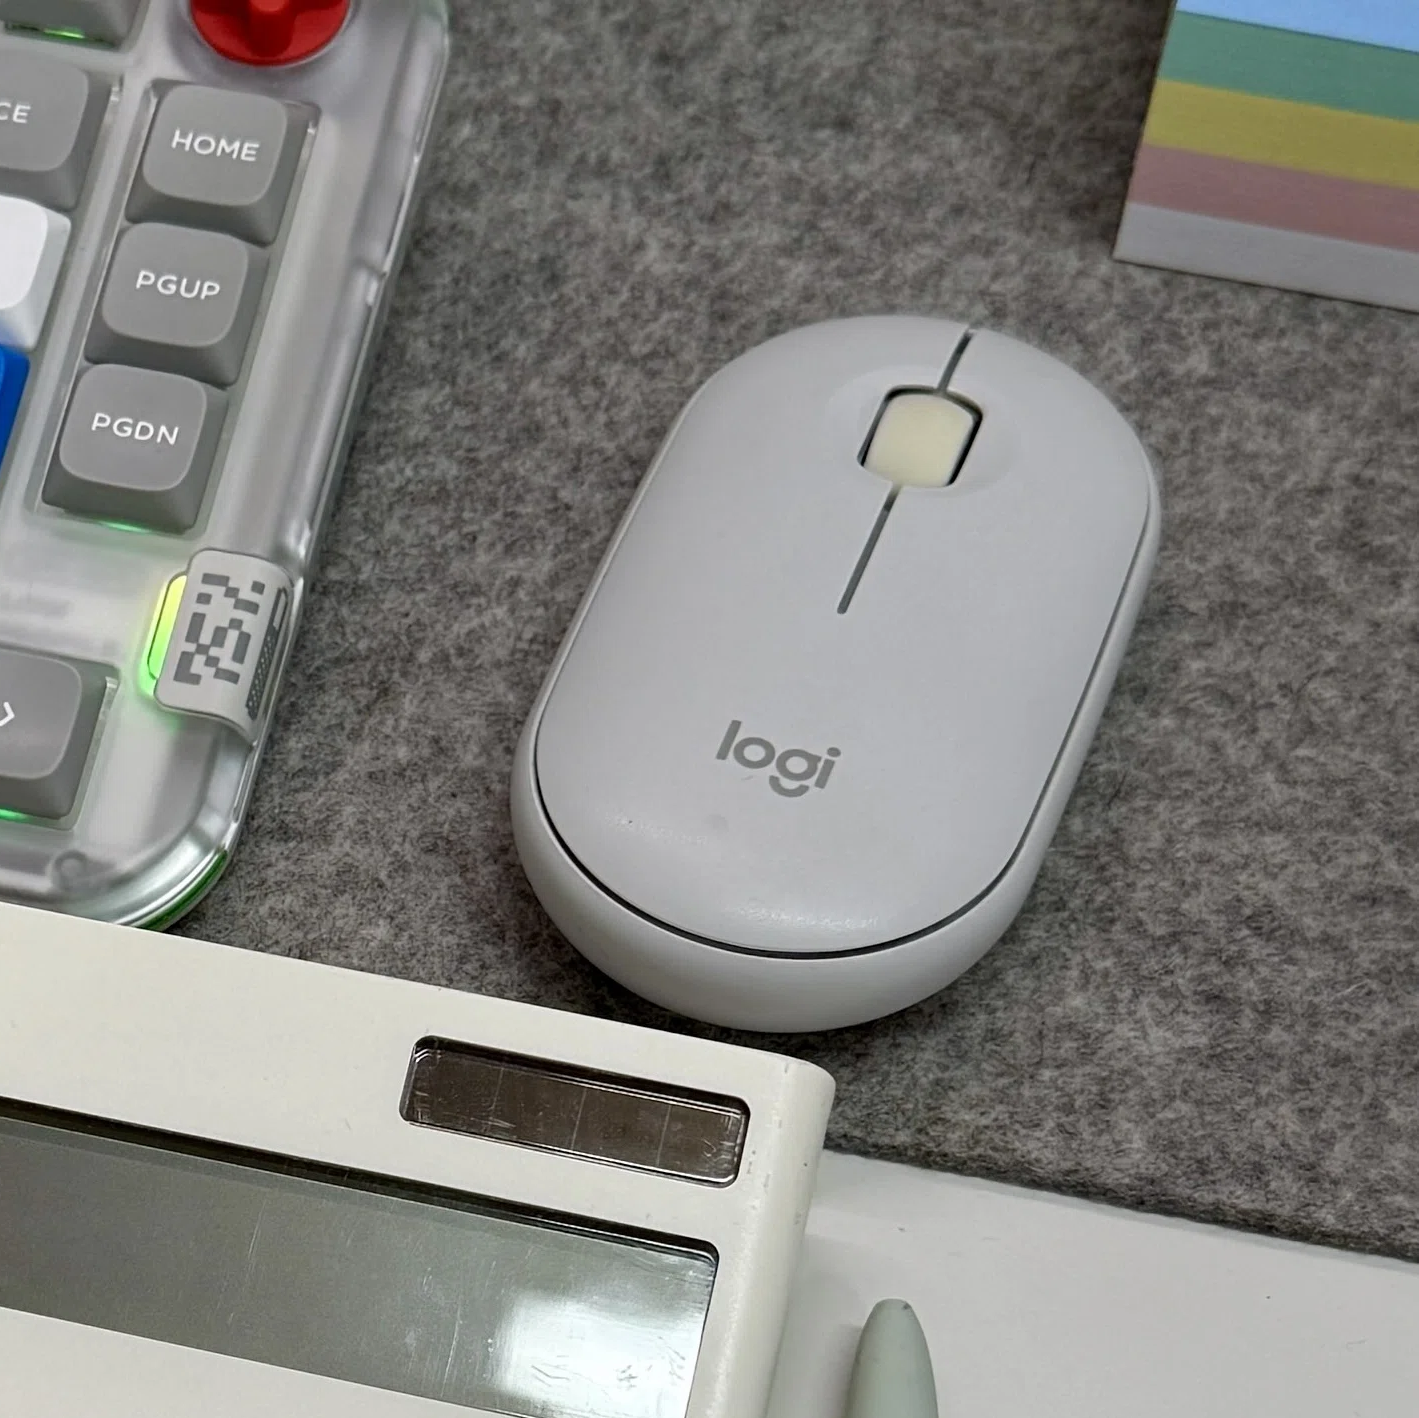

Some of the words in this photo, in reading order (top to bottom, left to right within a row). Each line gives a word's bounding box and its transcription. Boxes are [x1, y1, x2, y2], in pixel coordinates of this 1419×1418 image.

[171, 128, 260, 162] HOME
[135, 269, 221, 300] PGUP
[91, 412, 179, 445] PGDN
[715, 719, 842, 798] logi
